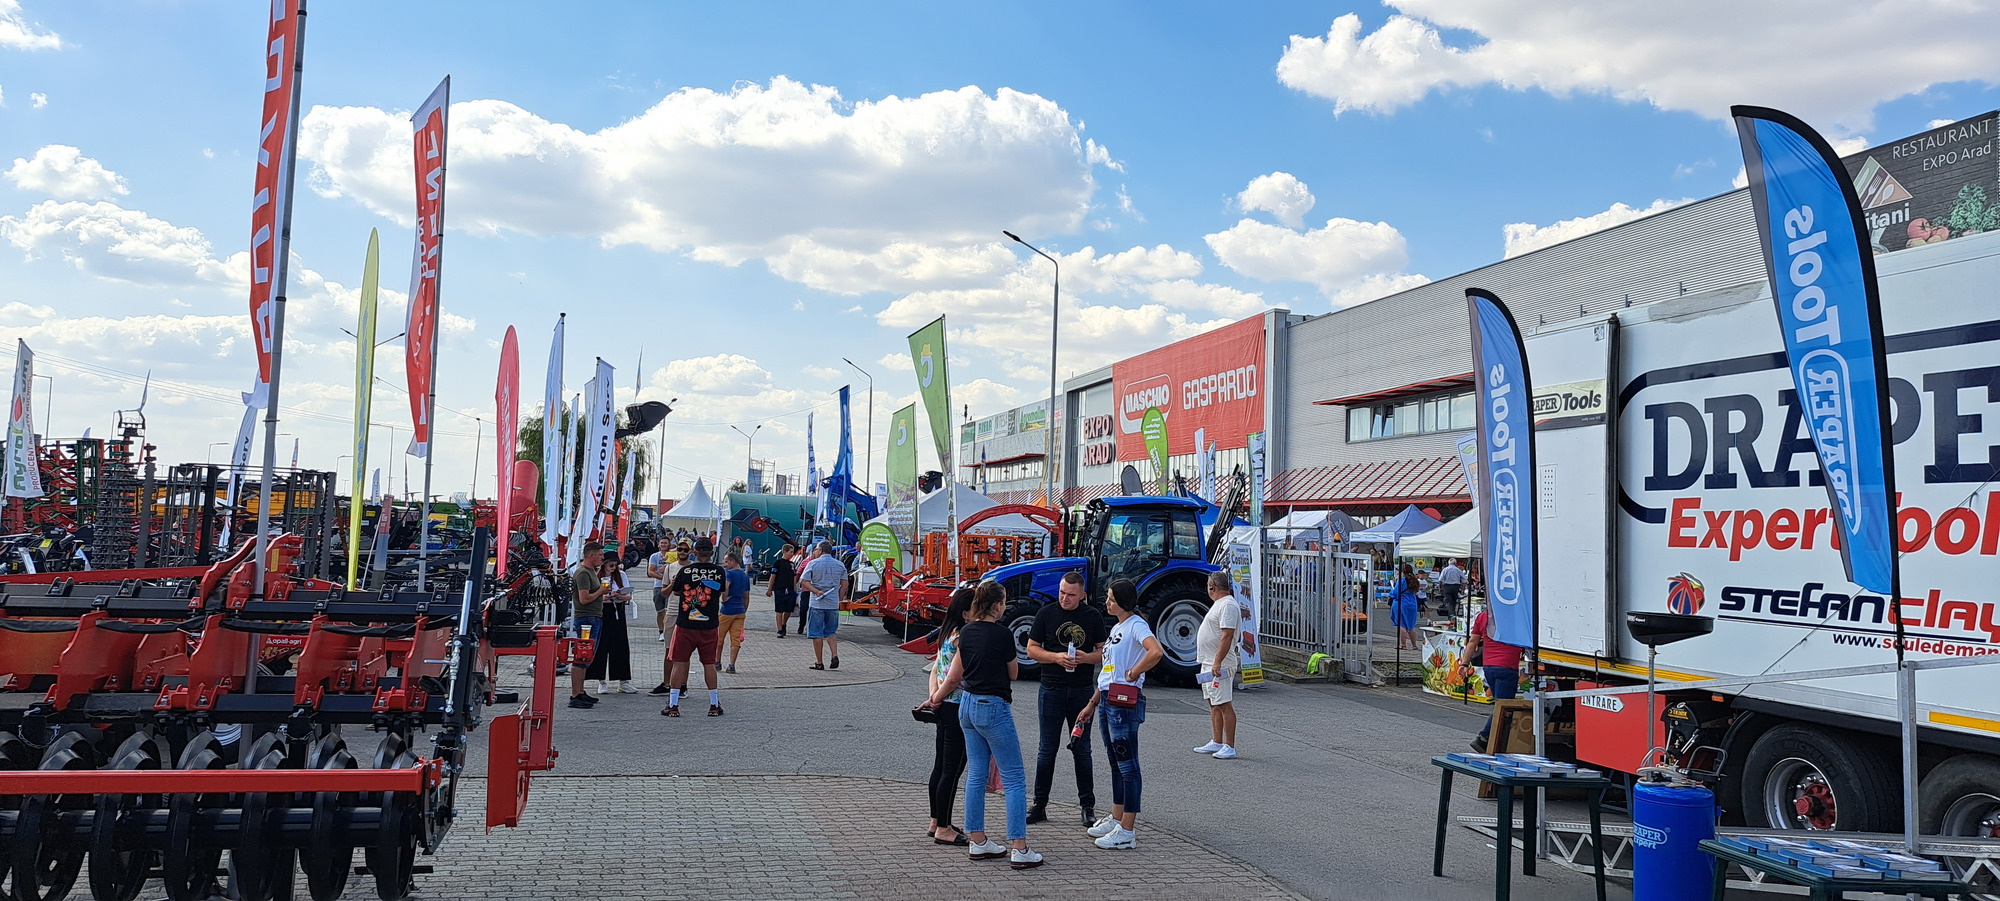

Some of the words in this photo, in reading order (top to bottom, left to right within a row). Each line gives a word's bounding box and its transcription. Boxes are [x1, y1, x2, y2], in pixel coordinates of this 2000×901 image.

[1892, 118, 1992, 160] RESTAURANT
[1922, 151, 1957, 172] EXPO
[1960, 141, 1991, 161] Arad
[1125, 383, 1170, 414] MASCHIO
[1183, 363, 1257, 410] GASPARDO
[1562, 390, 1602, 411] Tools
[1083, 414, 1113, 440] EXPO
[594, 434, 608, 506] heron
[1083, 442, 1113, 467] ARAD
[1897, 491, 2000, 555] ool
[691, 574, 722, 582] BACK
